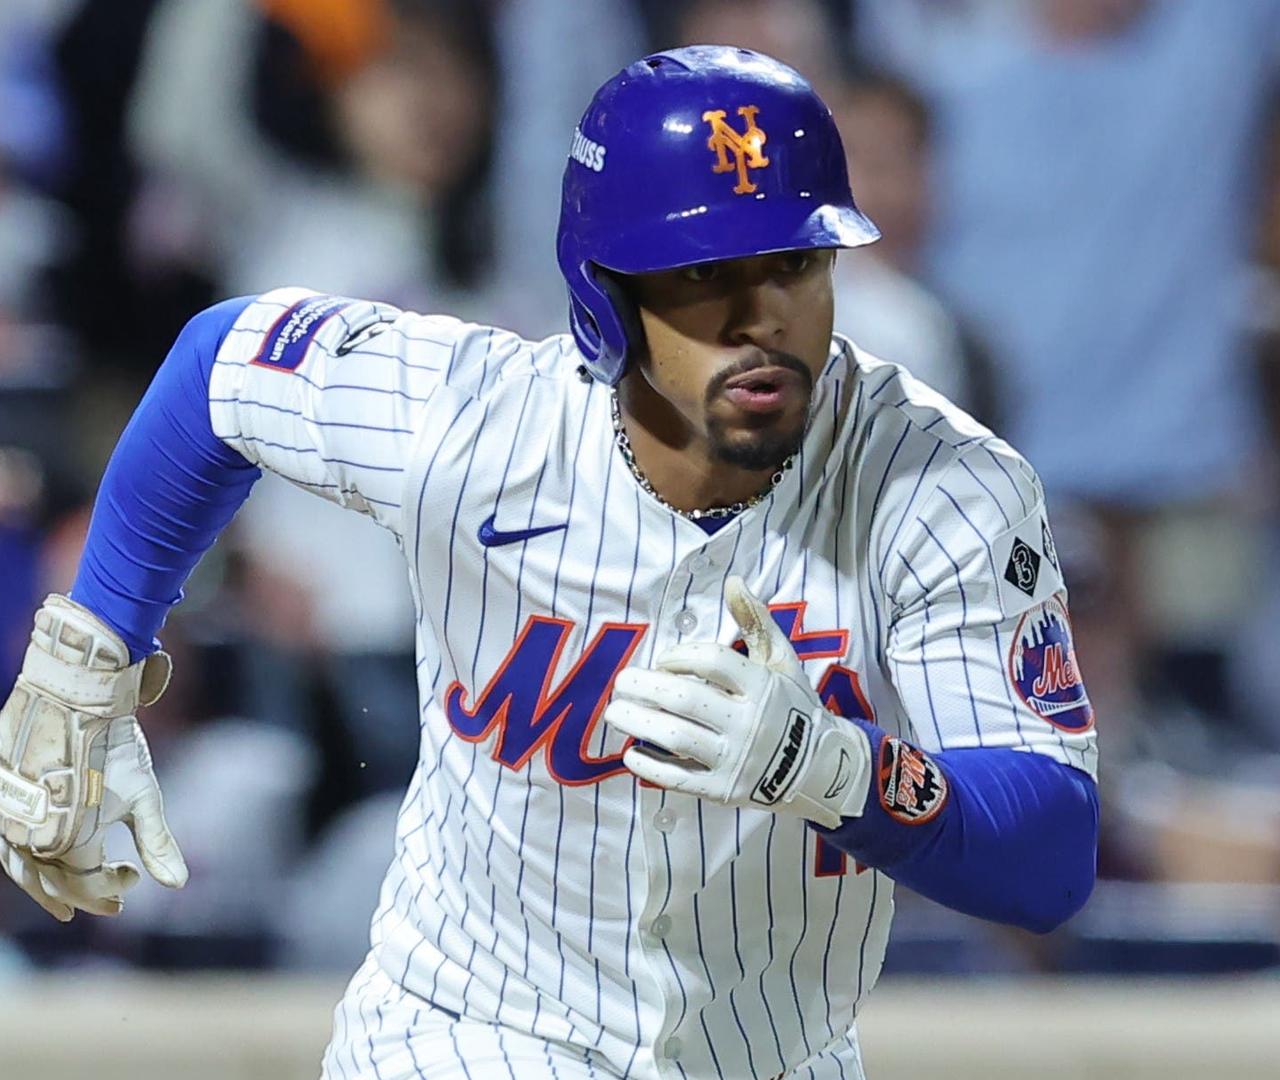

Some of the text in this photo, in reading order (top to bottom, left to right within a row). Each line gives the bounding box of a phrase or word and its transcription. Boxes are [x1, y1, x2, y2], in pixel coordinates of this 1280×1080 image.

[702, 105, 769, 194] NY
[1011, 543, 1036, 591] 3
[1032, 642, 1083, 697] Me
[759, 714, 806, 801] Franklin
